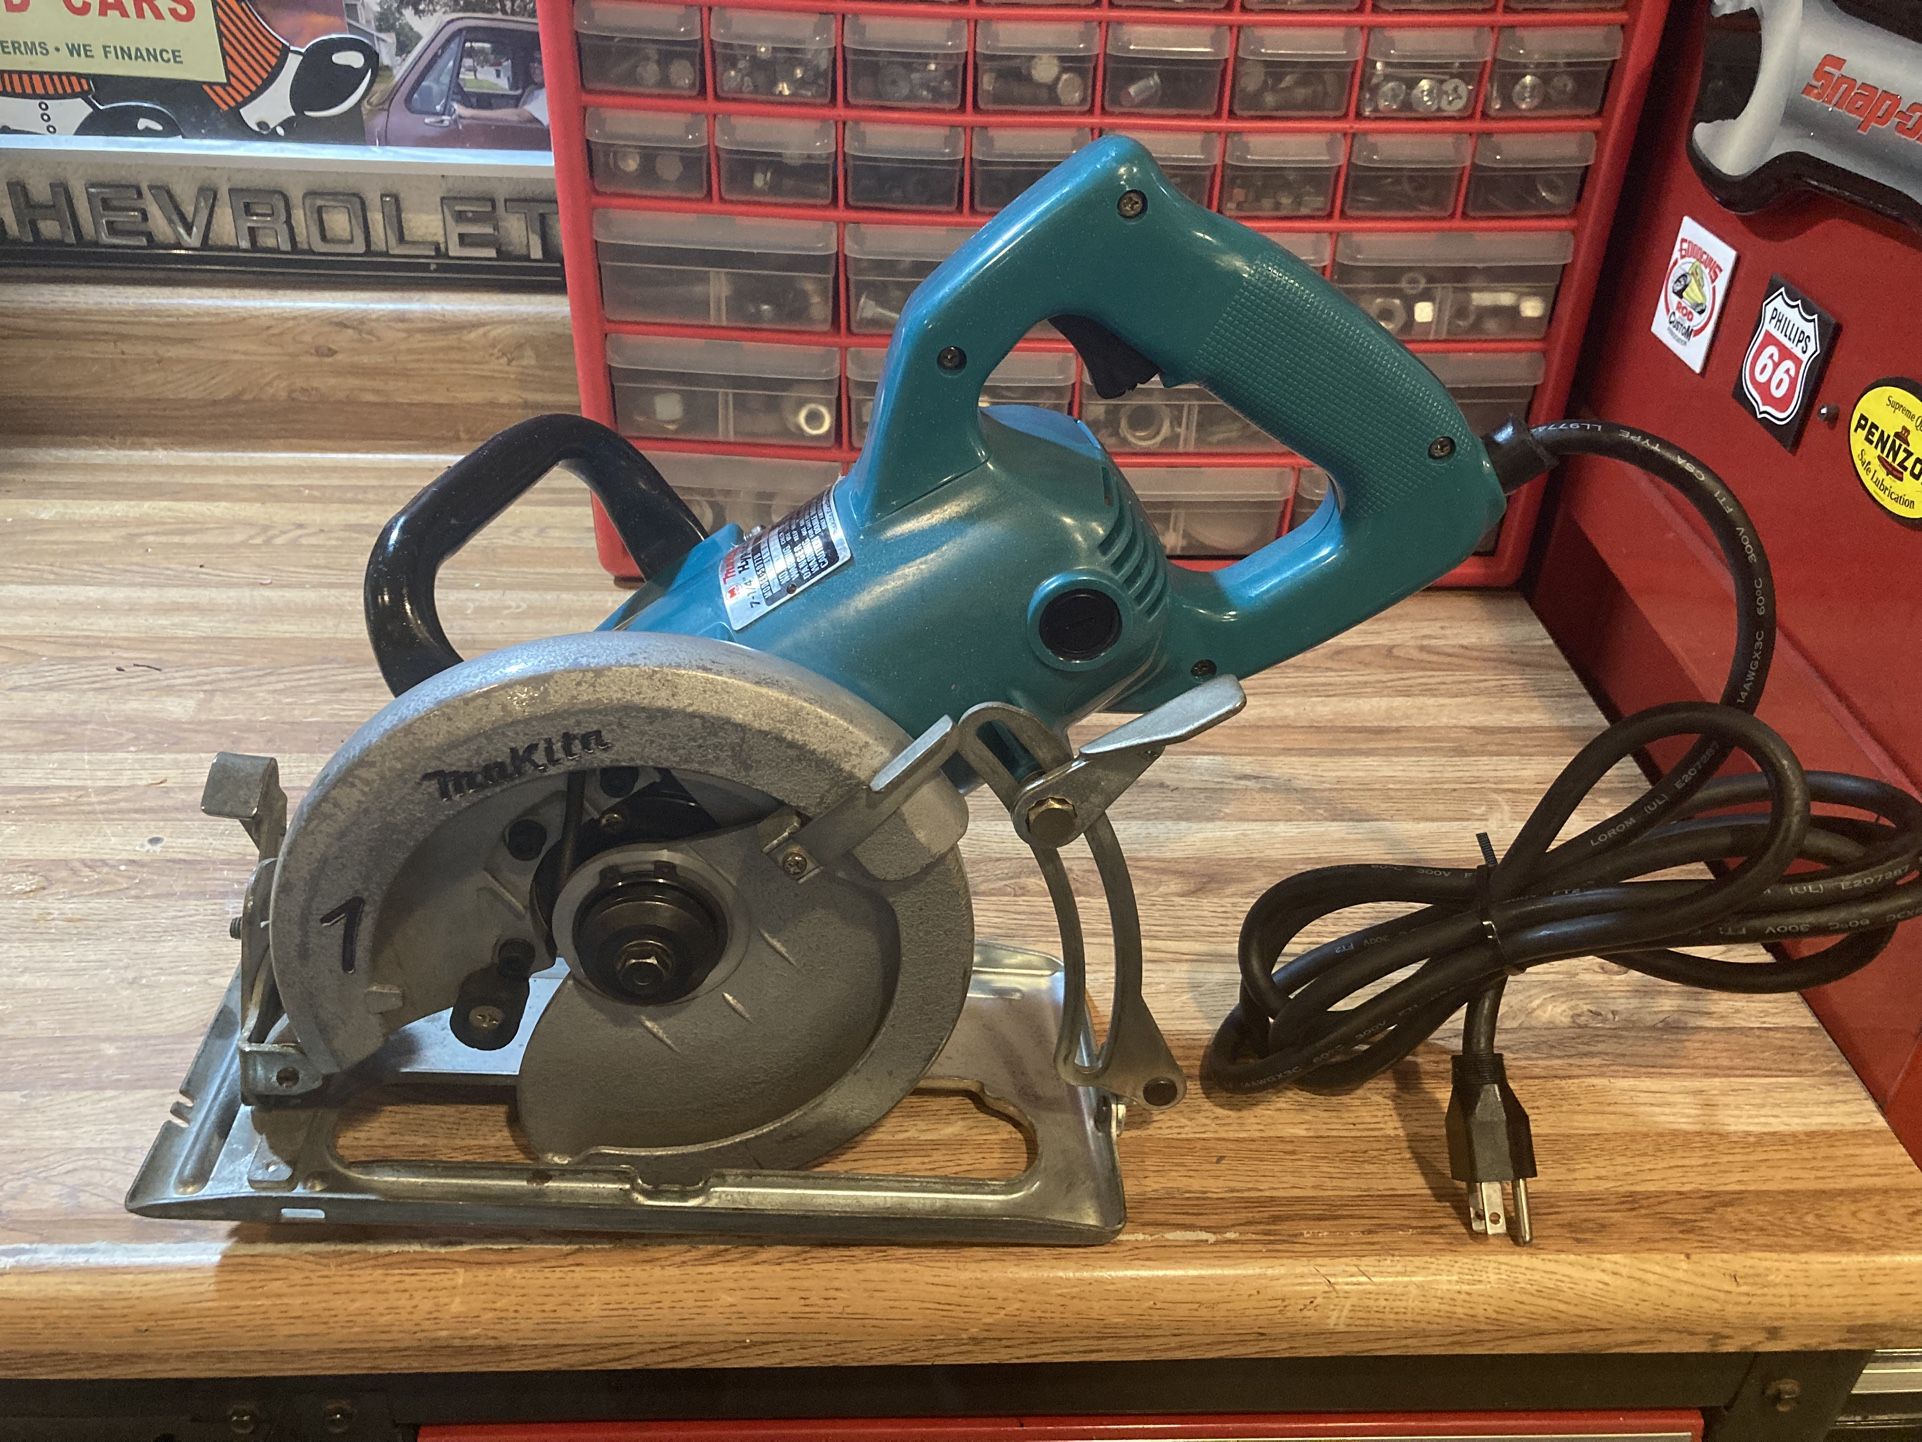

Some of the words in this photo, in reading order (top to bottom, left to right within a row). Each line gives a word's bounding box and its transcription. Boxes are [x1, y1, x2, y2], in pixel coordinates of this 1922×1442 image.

[65, 42, 94, 58] WE
[102, 45, 183, 64] FINANCE
[1801, 54, 1922, 144] Snap-o
[0, 179, 560, 260] HEVROLET
[1675, 301, 1694, 322] ROD
[1769, 308, 1811, 354] PHILLIPS
[1754, 345, 1796, 398] 66
[1886, 395, 1916, 423] Supreme
[1619, 429, 1662, 452] TYPE
[1854, 413, 1922, 485] PENNZO
[1676, 454, 1706, 482] CSA
[1858, 449, 1872, 475] Safe
[1871, 470, 1915, 509] Lubrication
[1713, 490, 1734, 514] FT1
[794, 543, 811, 580] DANGER
[1736, 527, 1757, 564] 300V
[1590, 818, 1636, 847] LOROM
[1644, 795, 1669, 815] (UL)
[1789, 885, 1824, 894] (UL)
[1765, 923, 1811, 935] 300V
